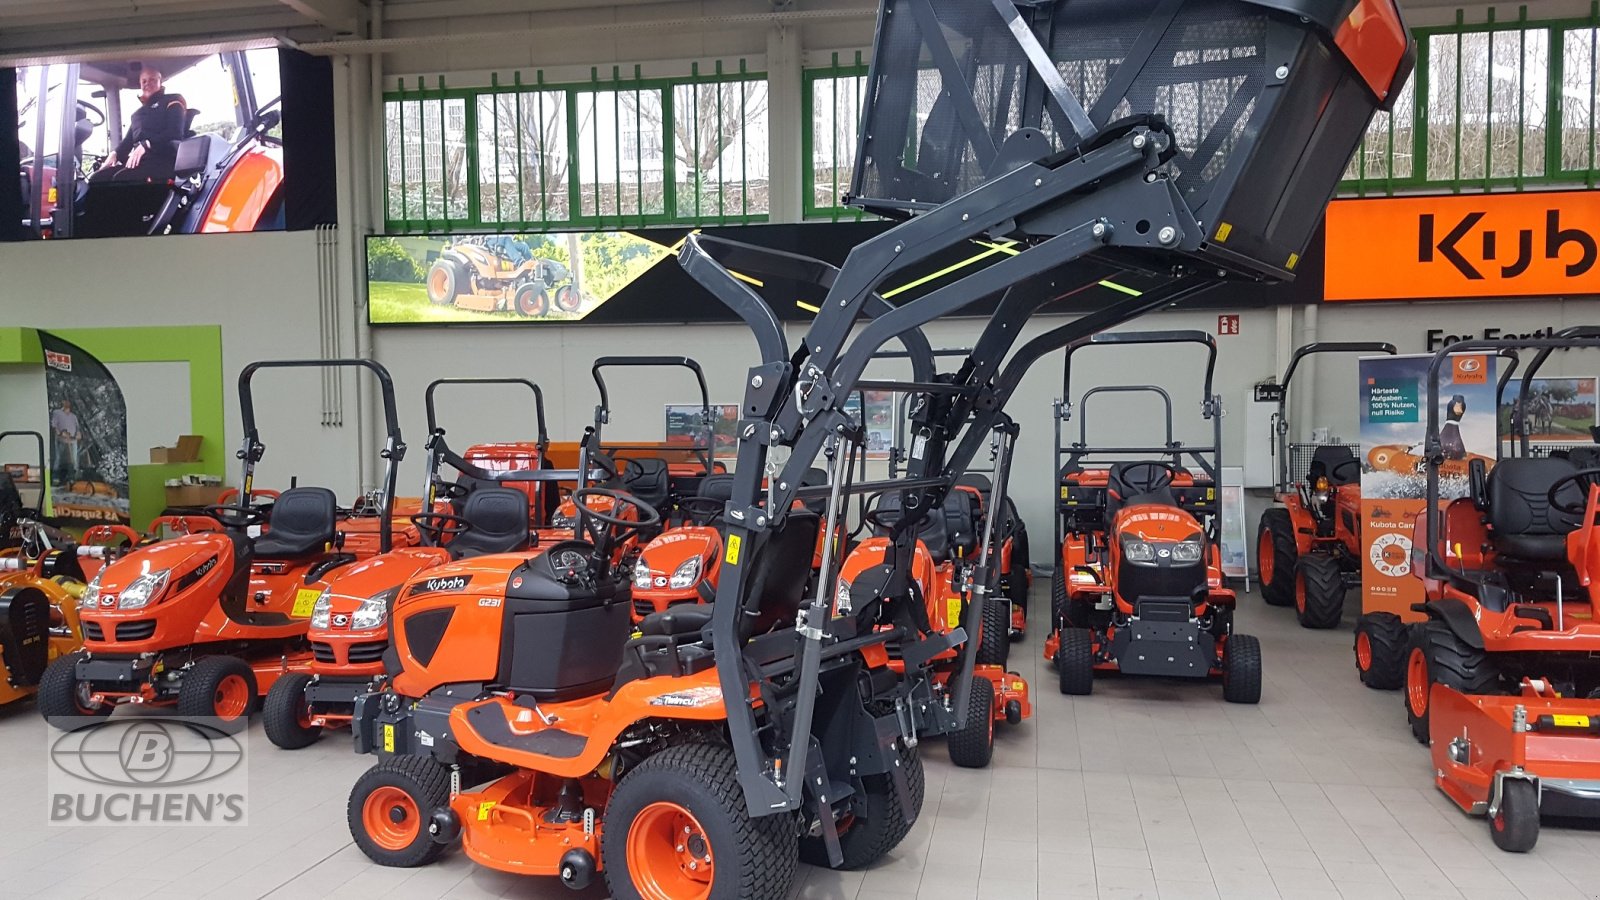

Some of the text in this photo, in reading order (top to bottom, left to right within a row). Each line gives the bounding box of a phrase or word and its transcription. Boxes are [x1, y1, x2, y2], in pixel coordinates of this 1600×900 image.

[1371, 387, 1399, 395] Härteste
[1370, 521, 1415, 529] Kubota Care
[195, 558, 217, 577] Kubota
[427, 576, 465, 591] Kubota
[478, 598, 501, 608] G231
